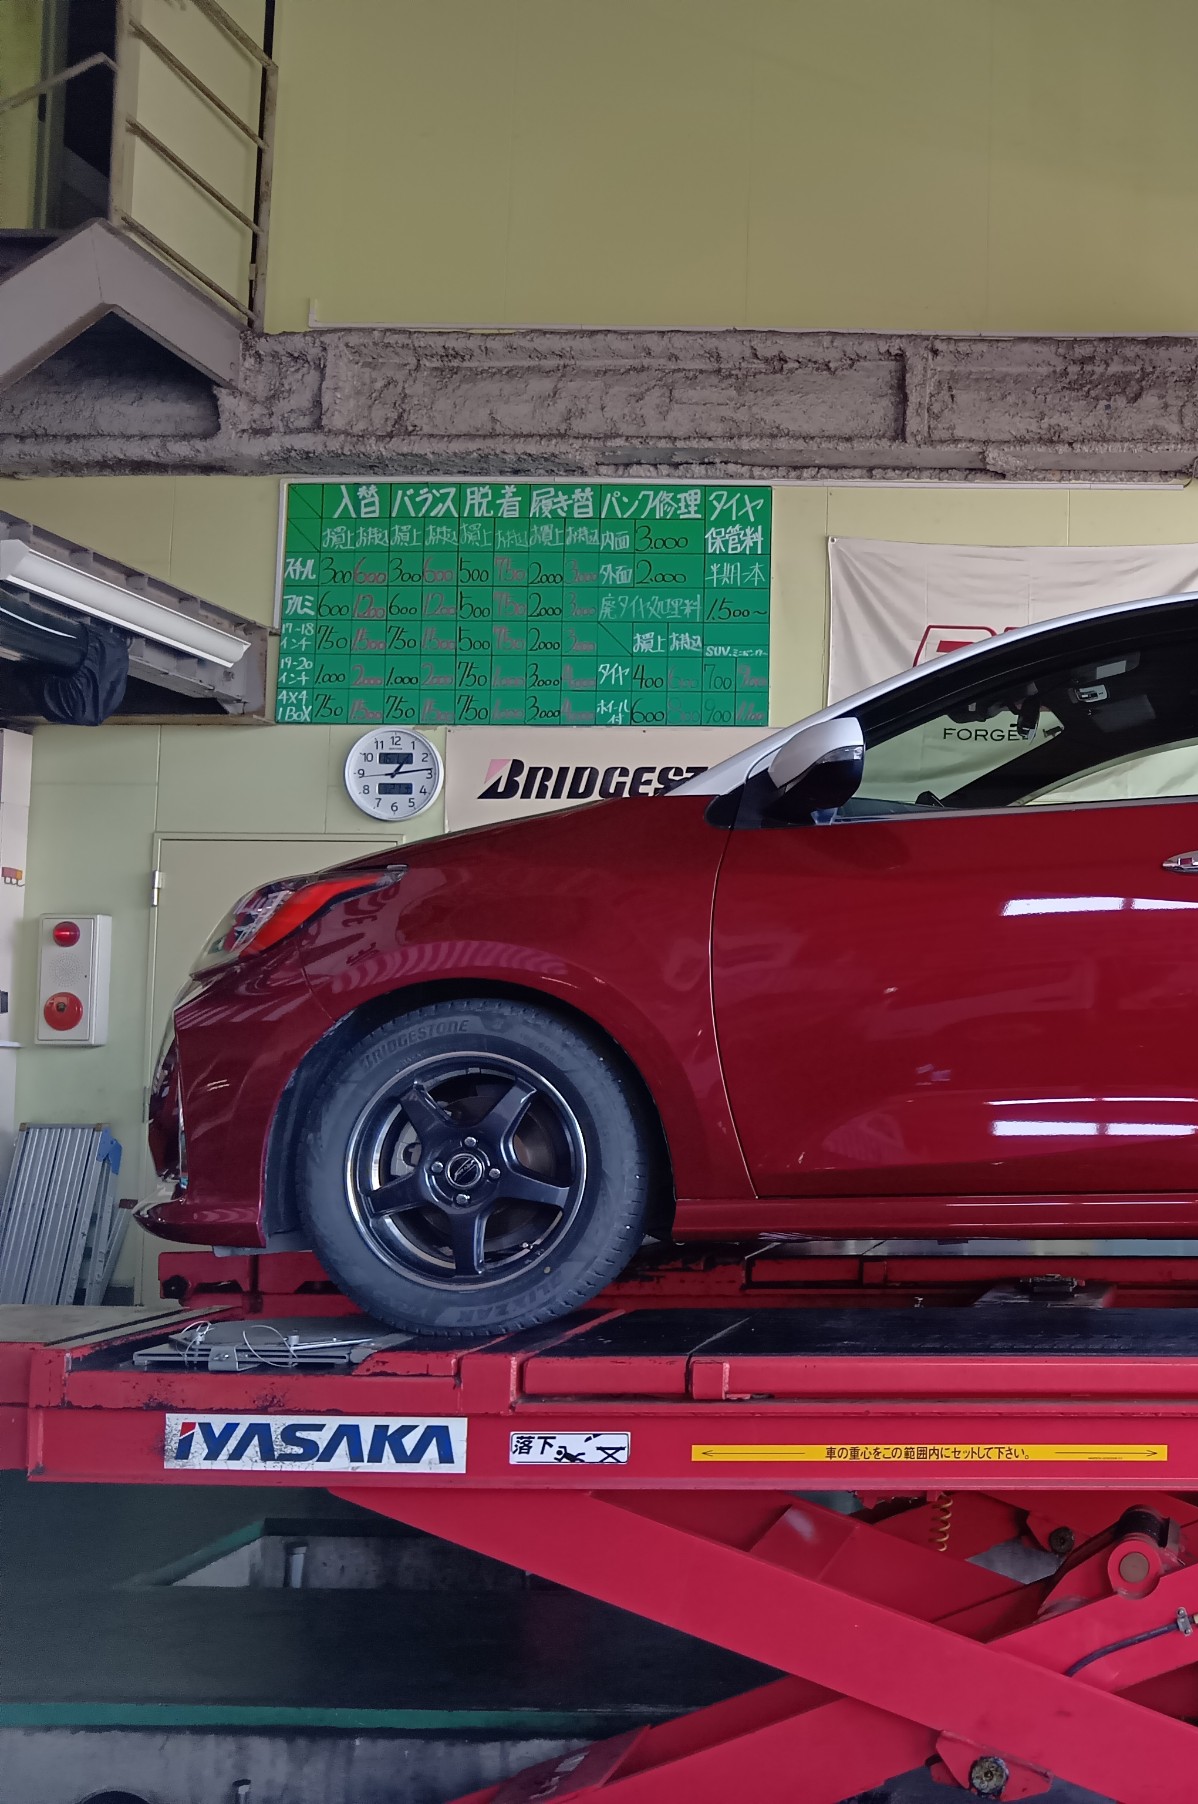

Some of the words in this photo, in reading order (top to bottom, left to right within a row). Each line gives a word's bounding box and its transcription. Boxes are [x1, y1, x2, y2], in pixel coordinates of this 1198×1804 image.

[333, 484, 380, 519] 入替
[391, 487, 459, 518] バランス
[463, 484, 522, 518] 脱着
[601, 489, 702, 519] パンク修理
[708, 490, 764, 522] タイヤ
[600, 530, 630, 551] 内面
[704, 523, 764, 555] 保管料
[321, 557, 352, 585] 300
[389, 557, 422, 584] 300
[459, 557, 489, 584] 500
[600, 563, 633, 585] 外面
[318, 590, 349, 618] 600
[388, 592, 417, 616] 600
[459, 590, 491, 620] 500
[317, 624, 348, 650] 750
[387, 625, 417, 650] 750
[458, 626, 490, 652] 500
[457, 661, 488, 688] 750
[598, 662, 630, 686] タイヤ
[632, 664, 664, 689] 400
[704, 663, 732, 690] 700
[314, 693, 344, 718] 750
[385, 695, 415, 719] 750
[456, 694, 489, 721] 750
[630, 697, 665, 724] 600
[390, 735, 401, 746] 12
[943, 727, 1028, 741] FORGE
[374, 740, 384, 750] 11
[410, 740, 415, 750] 1
[362, 752, 374, 763] 10
[421, 752, 429, 763] 2
[357, 768, 365, 778] 9
[426, 768, 433, 780] 3
[362, 784, 370, 795] 8
[419, 785, 427, 796] 4
[375, 797, 382, 808] 7
[390, 801, 398, 812] 6
[408, 797, 415, 808] 5
[360, 1018, 470, 1071] BRIDGESTONE
[174, 1421, 455, 1465] IYASAKA
[512, 1435, 557, 1455] 落下
[825, 1446, 1031, 1460] 車の重心をこの範囲内にセットして下さい。
